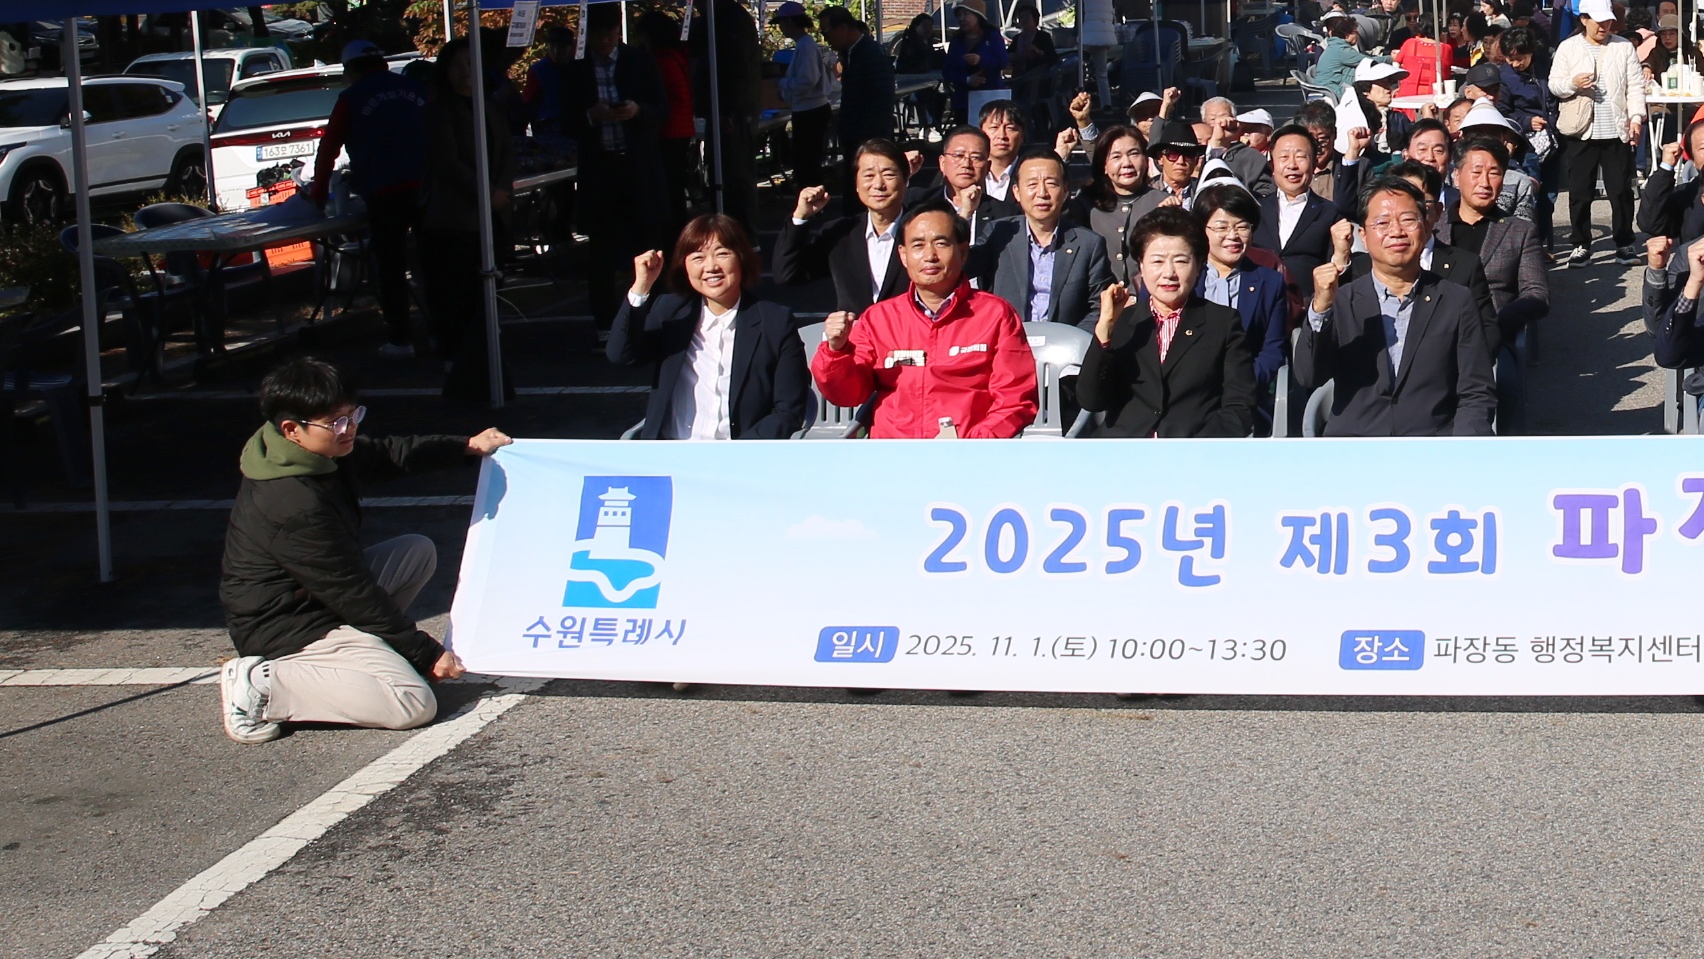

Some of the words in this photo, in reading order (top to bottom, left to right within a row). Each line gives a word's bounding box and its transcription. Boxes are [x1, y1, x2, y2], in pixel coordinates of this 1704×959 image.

[289, 143, 310, 154] 7361
[924, 504, 1227, 588] 2025년
[1280, 508, 1497, 575] 제3회
[522, 615, 688, 648] 수원특례시
[832, 630, 885, 658] 일시
[904, 634, 977, 657] 2025.
[990, 636, 1018, 657] 11.
[1032, 635, 1098, 661] 1.(토)
[1108, 637, 1288, 662] 10:00~13:30
[1353, 635, 1411, 664] 장소
[1433, 635, 1520, 664] 파장동
[1530, 634, 1702, 664] 행정복지센터
